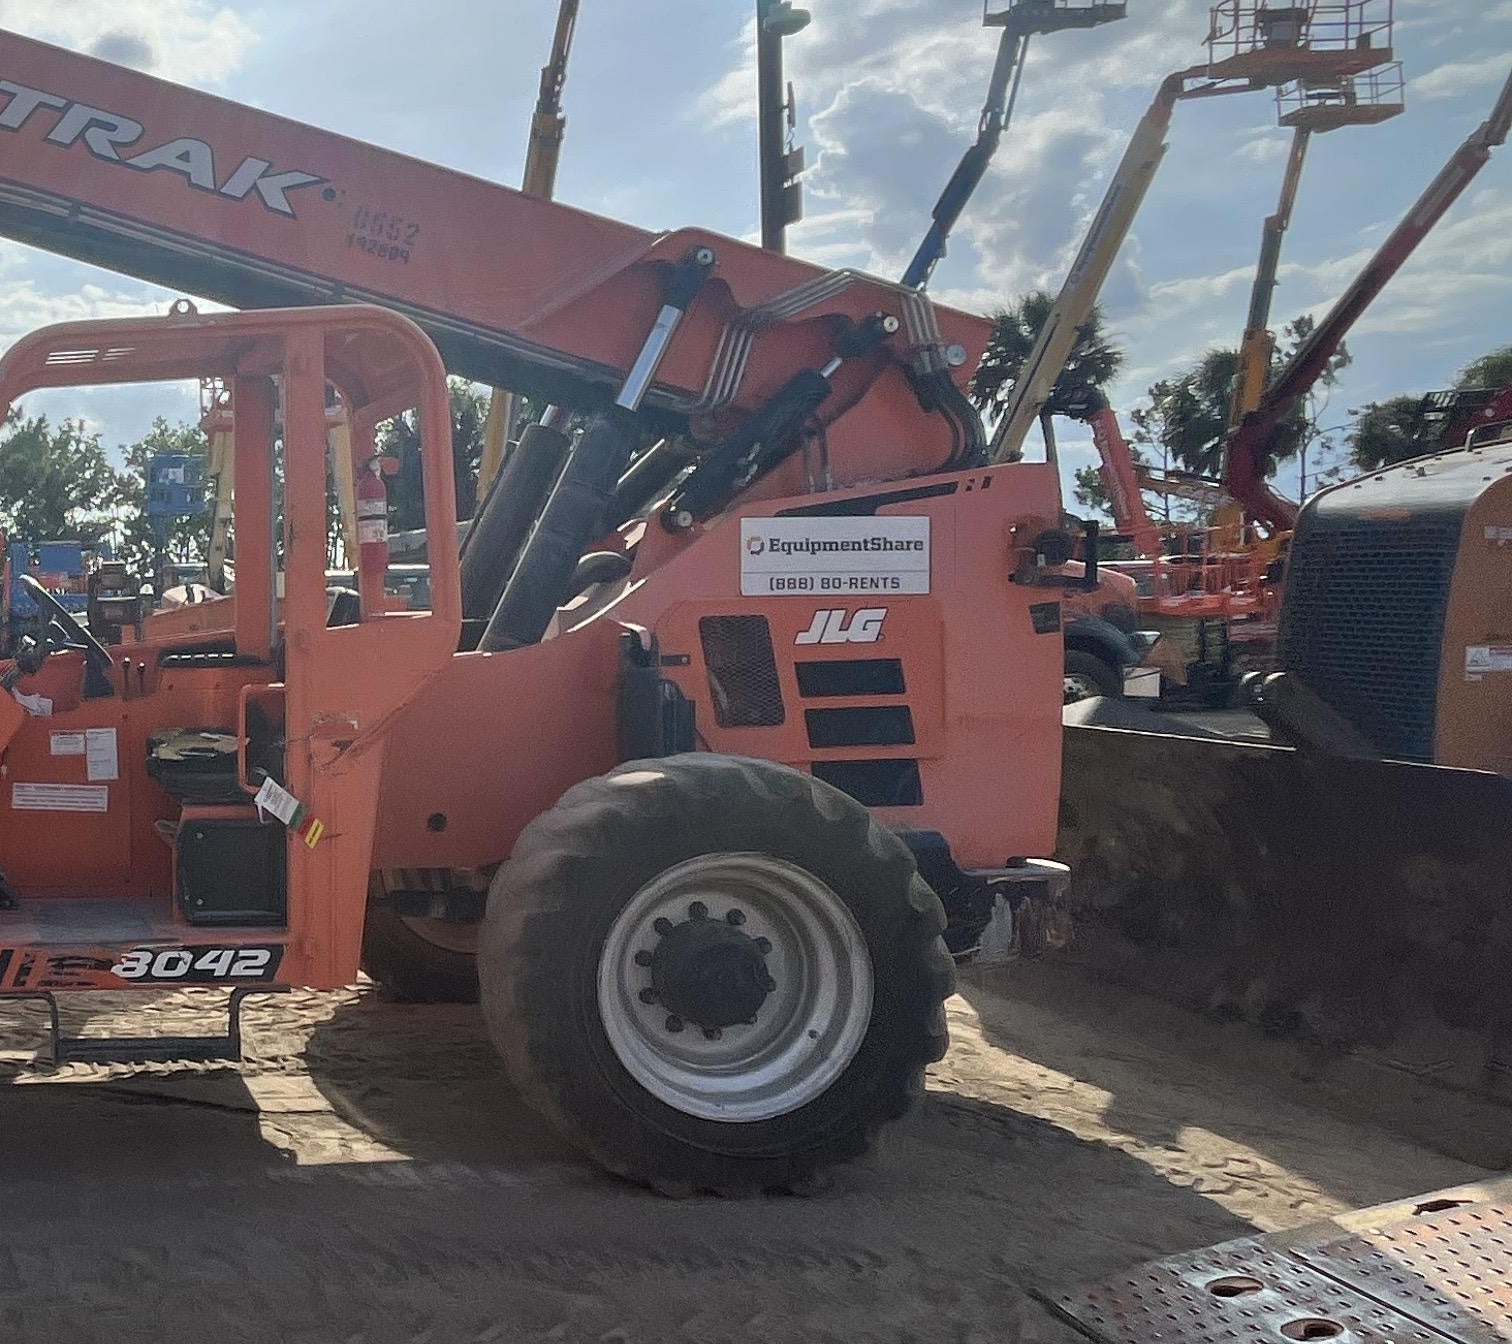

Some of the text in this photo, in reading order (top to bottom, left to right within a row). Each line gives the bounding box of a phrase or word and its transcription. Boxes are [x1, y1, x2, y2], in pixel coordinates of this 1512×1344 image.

[768, 537, 924, 555] EquipmentShare
[769, 576, 901, 591] (888) 80-RENTS
[794, 608, 888, 645] JLG
[110, 948, 271, 979] 8042
